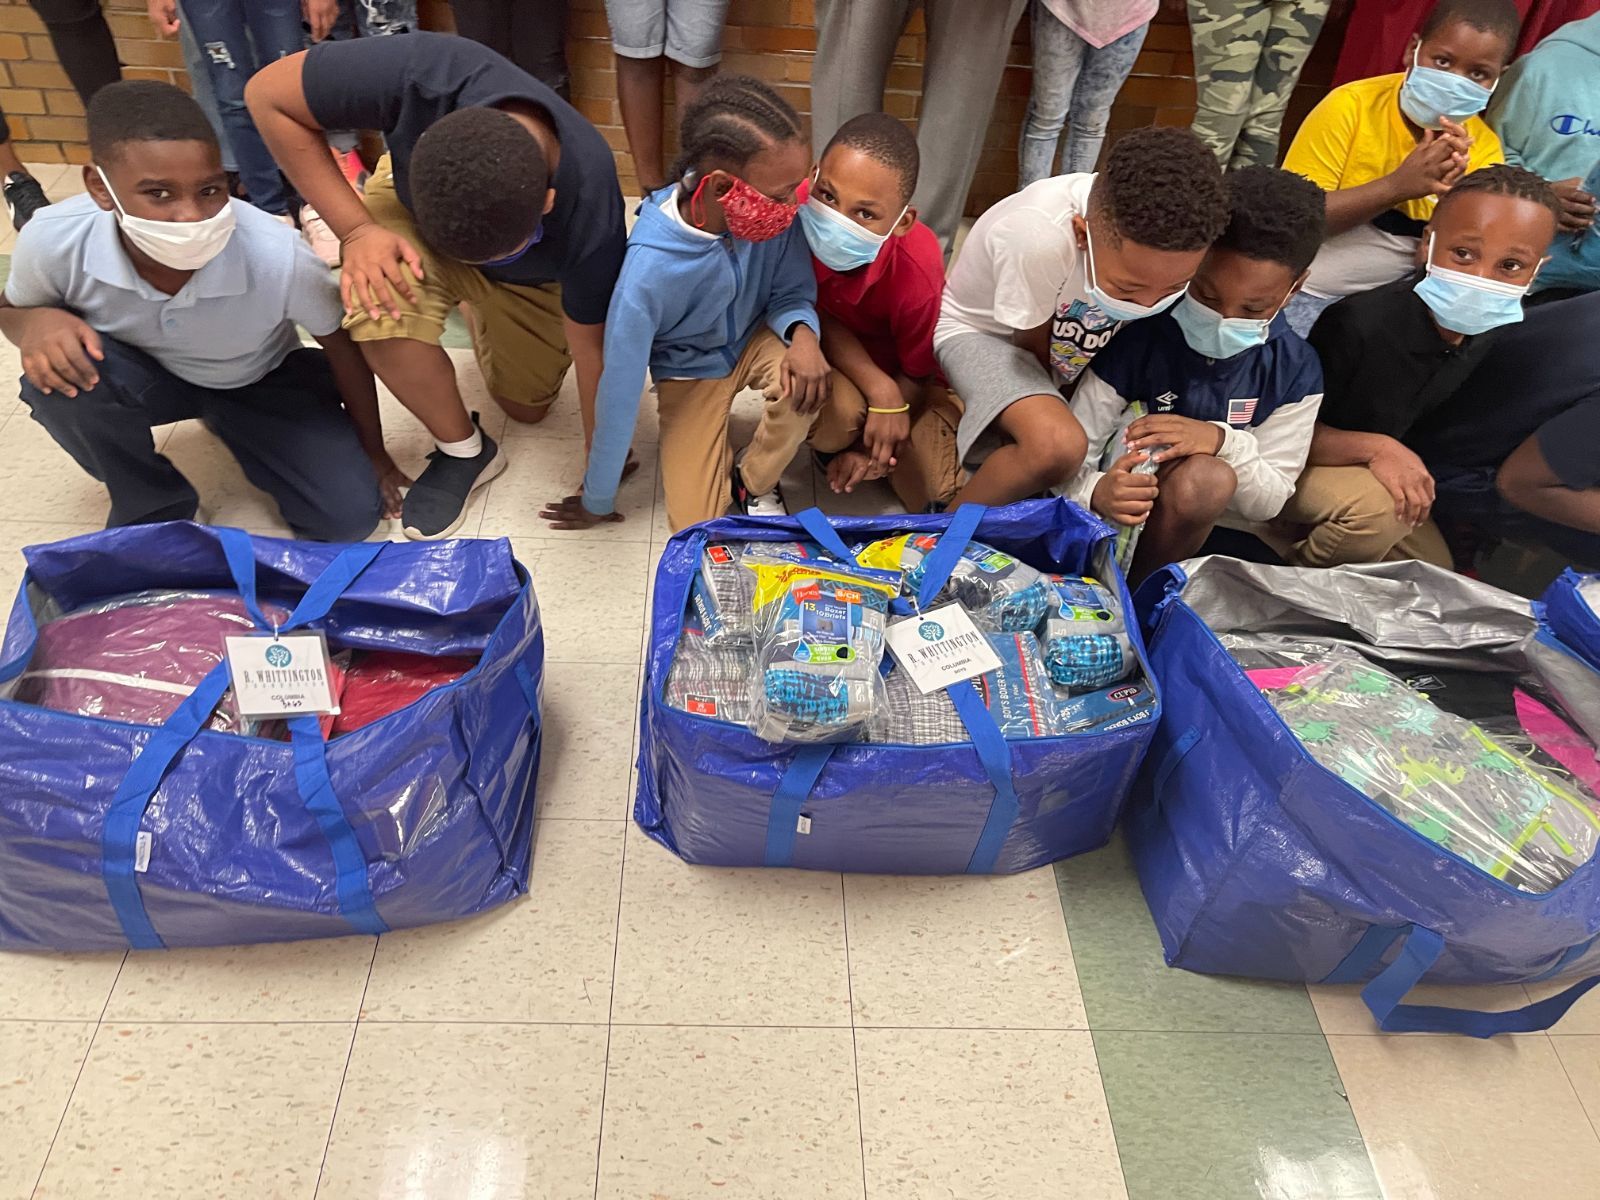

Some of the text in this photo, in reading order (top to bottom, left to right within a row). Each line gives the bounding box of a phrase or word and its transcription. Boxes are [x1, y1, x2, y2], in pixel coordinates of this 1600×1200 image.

[1053, 319, 1085, 343] UST
[1083, 331, 1112, 349] DO
[804, 602, 816, 611] 13
[918, 630, 980, 660] WHITTINGTON
[244, 668, 323, 683] R. WHITTINGTON
[997, 679, 1009, 700] BOXER
[1113, 687, 1138, 699] CUPID
